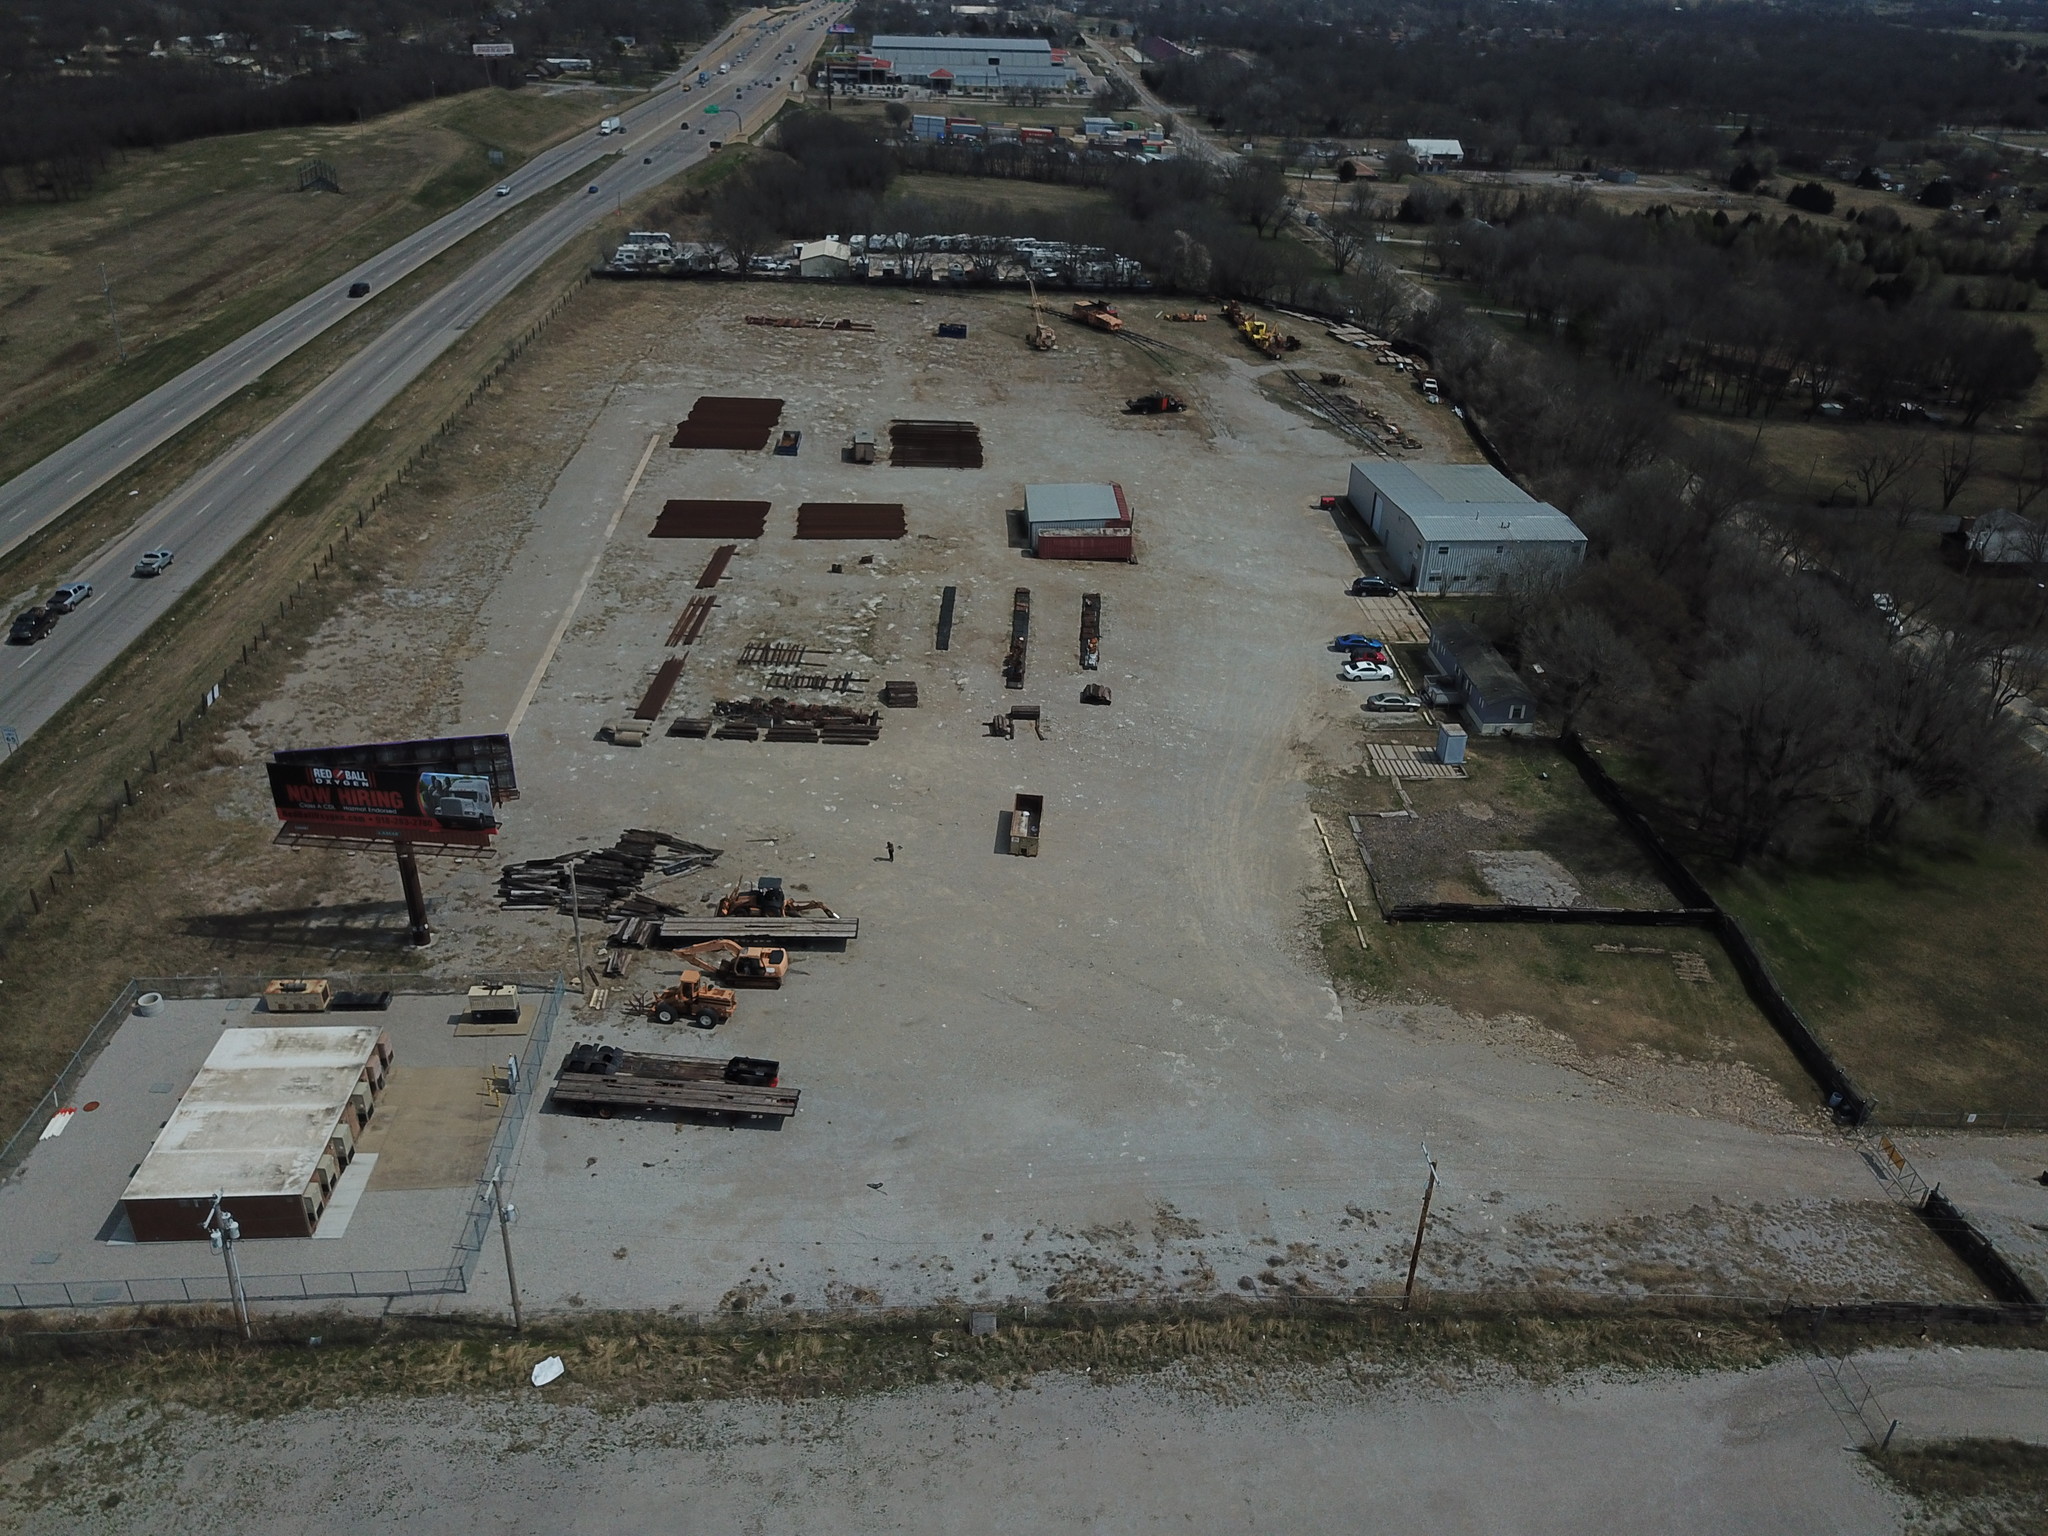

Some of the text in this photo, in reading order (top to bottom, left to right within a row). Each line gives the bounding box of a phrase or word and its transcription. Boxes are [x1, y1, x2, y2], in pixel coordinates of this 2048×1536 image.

[313, 768, 368, 781] RED BALL
[315, 778, 369, 787] OXYGEN
[286, 784, 404, 809] NOW HIRING
[368, 806, 397, 815] Endorsed
